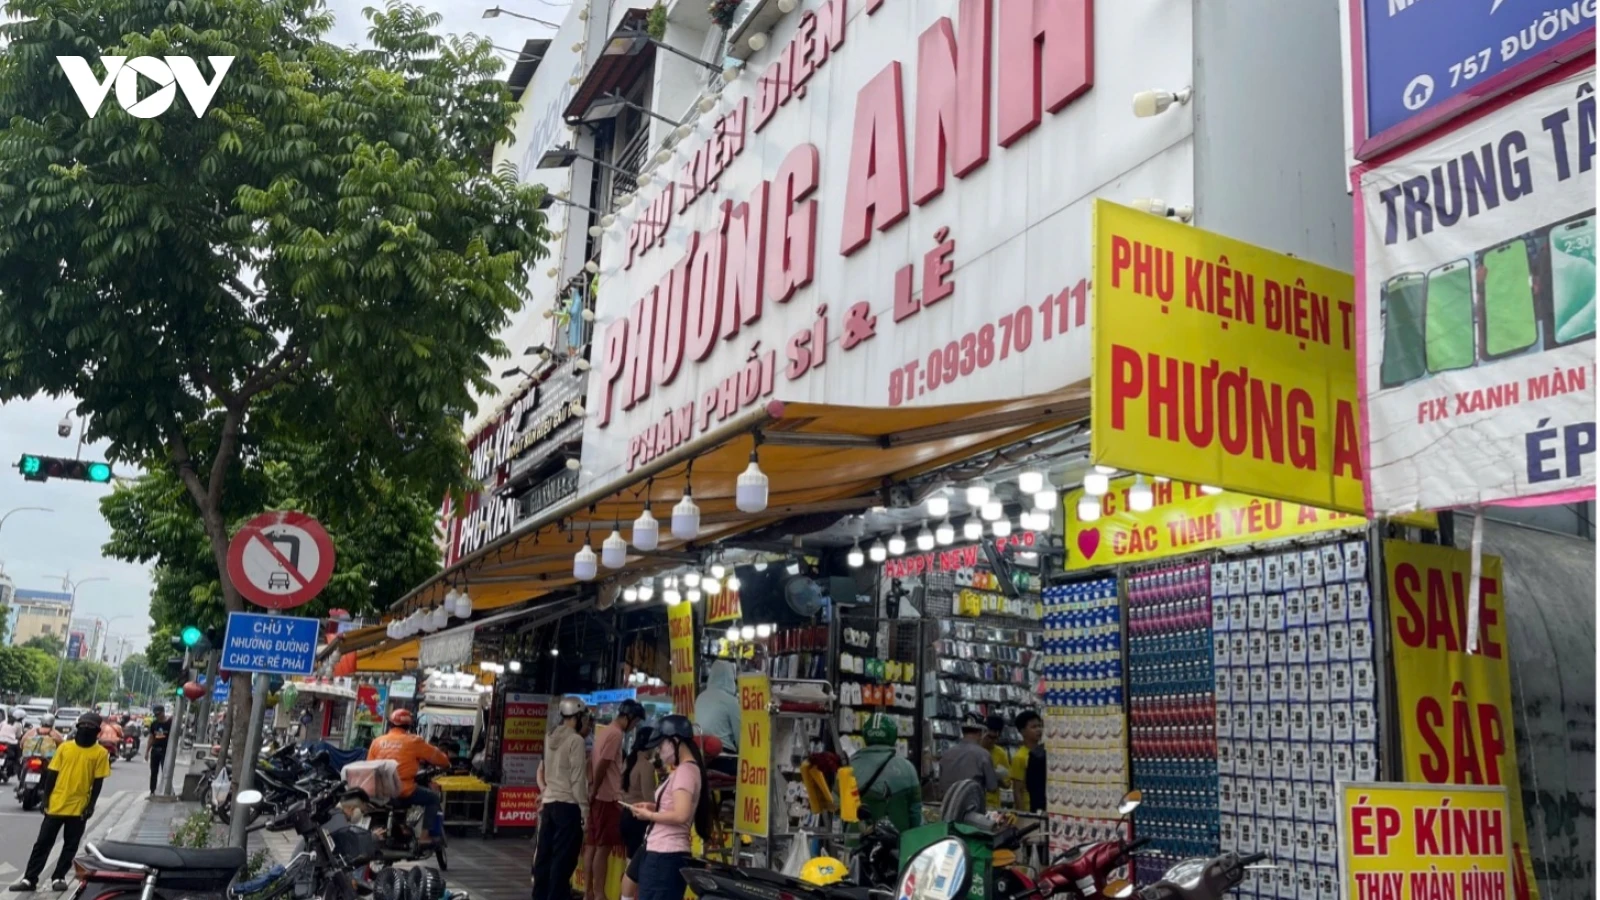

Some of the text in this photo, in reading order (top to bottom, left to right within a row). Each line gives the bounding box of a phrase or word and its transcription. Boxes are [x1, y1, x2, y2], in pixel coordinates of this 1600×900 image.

[1448, 47, 1491, 89] 757
[624, 0, 848, 271] PHỤ KIỆN ĐIỆN
[597, 0, 1094, 428] PHƯƠNG ANH
[1379, 130, 1534, 246] TRUNG
[1038, 278, 1093, 342] 111
[1111, 234, 1174, 314] PHỤ
[1185, 255, 1255, 330] KIỆN
[1264, 277, 1330, 351] ĐIỆN
[626, 400, 694, 473] PHÂN
[700, 340, 776, 432] PHỐI
[840, 300, 877, 352] &
[893, 225, 956, 324] LẺ
[1111, 343, 1317, 472] PHƯƠNG
[1417, 366, 1586, 424] FIX XANH MÀN
[1525, 416, 1596, 484] ÉP
[1113, 523, 1157, 556] CÁC
[1167, 512, 1221, 548] TÌNH
[1235, 499, 1283, 535] YÊU
[885, 552, 935, 578] HAPPY
[939, 545, 979, 571] NEW
[253, 621, 294, 635] CHÚ Ý
[229, 653, 250, 665] CHO
[251, 655, 265, 667] XE
[281, 655, 305, 670] PHẢI
[741, 759, 767, 786] Đam
[743, 797, 761, 824] Mê
[1351, 796, 1504, 855] ÉP KÍNH
[1355, 872, 1404, 900] THAY
[1410, 864, 1455, 900] MÀN
[1461, 864, 1505, 900] HÌNH
